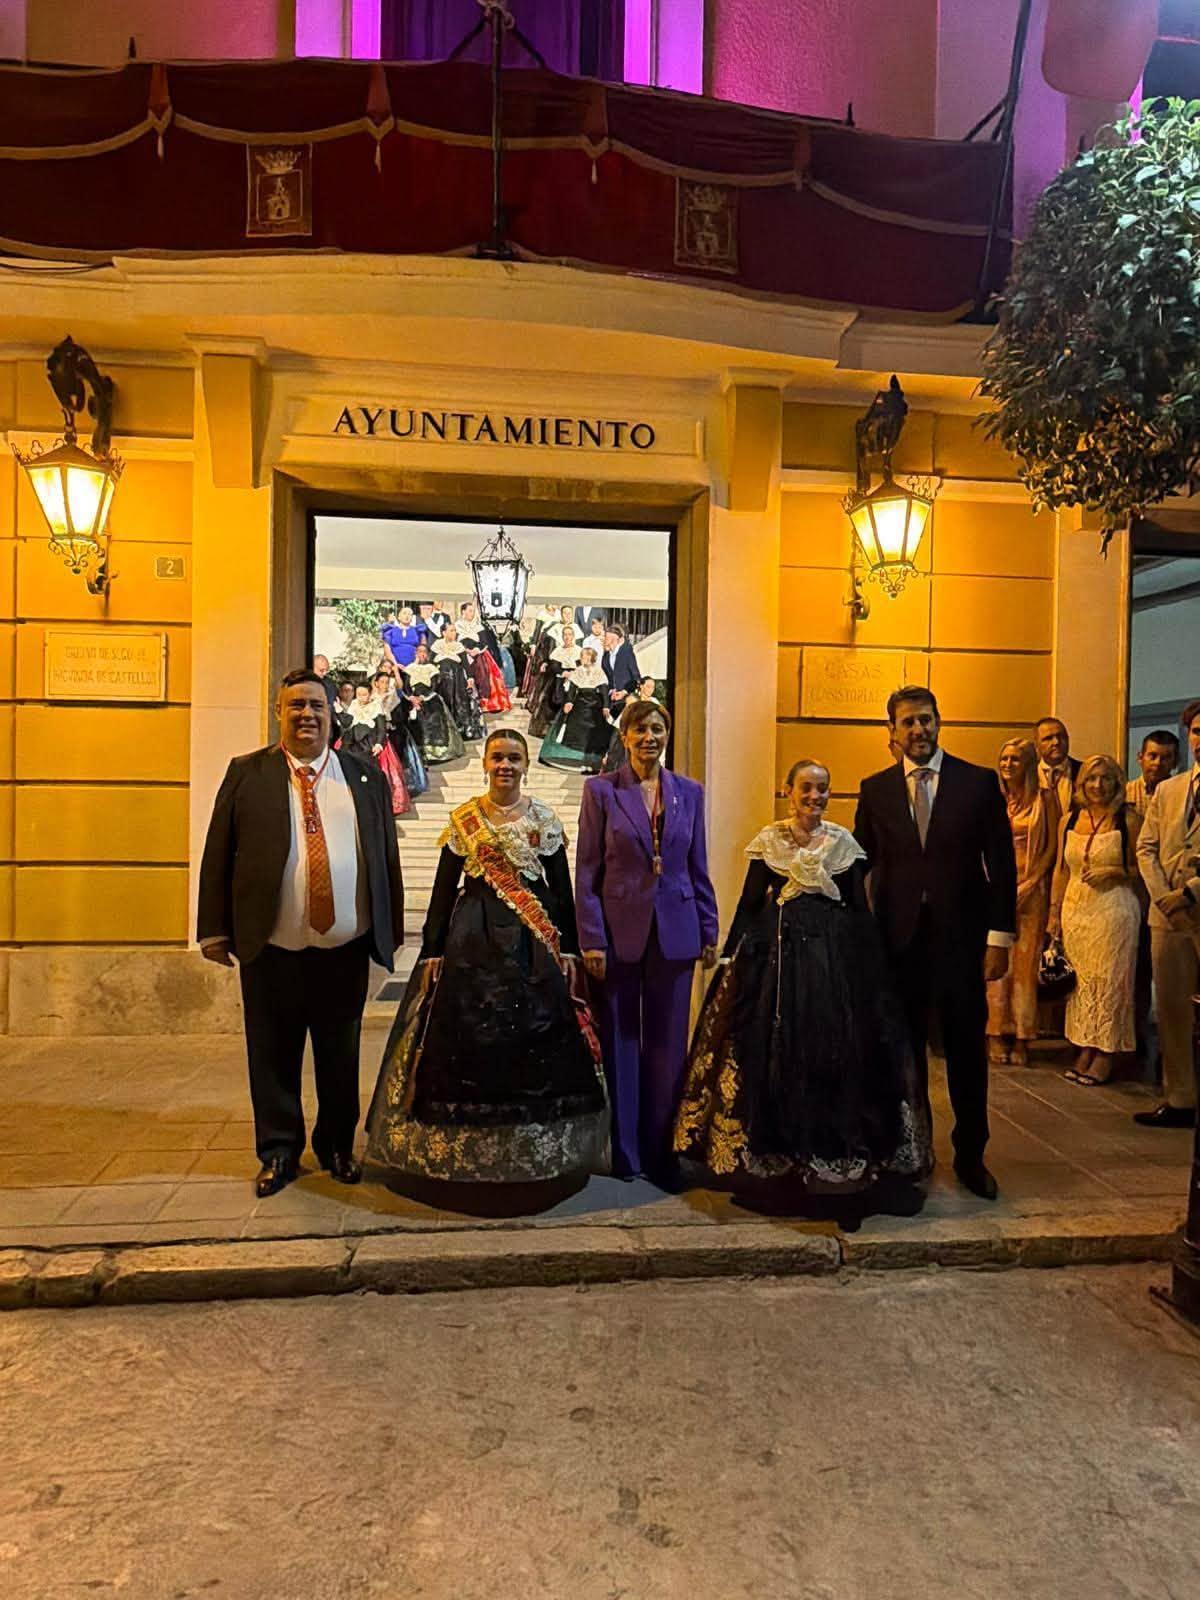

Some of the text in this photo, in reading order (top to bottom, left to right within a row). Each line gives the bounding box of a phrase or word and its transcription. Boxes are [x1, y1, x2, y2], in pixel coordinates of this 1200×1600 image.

[333, 406, 656, 450] AYUNTAMIENTO
[166, 560, 174, 575] 2
[824, 662, 882, 681] CASAS
